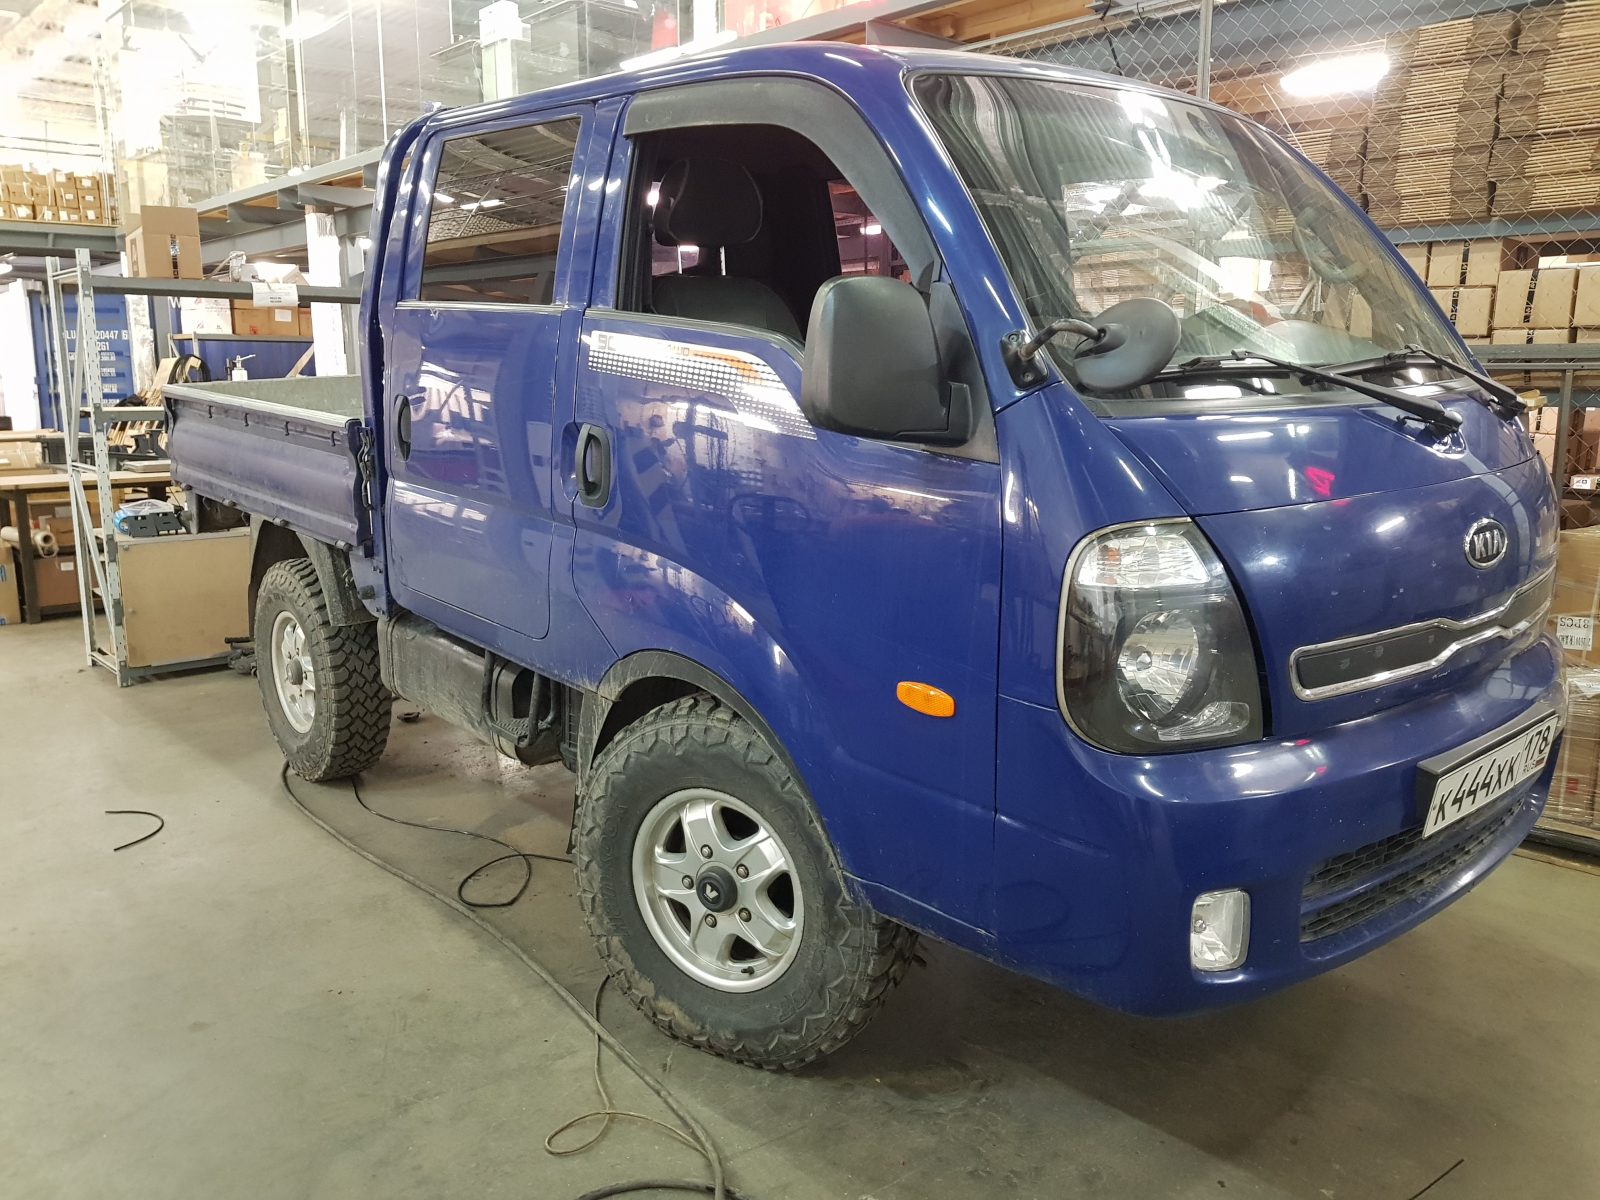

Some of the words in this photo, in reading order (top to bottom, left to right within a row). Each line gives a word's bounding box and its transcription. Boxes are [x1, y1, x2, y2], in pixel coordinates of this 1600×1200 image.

[1473, 528, 1503, 560] KIA
[1433, 752, 1521, 826] K444XK
[1524, 725, 1551, 764] 178
